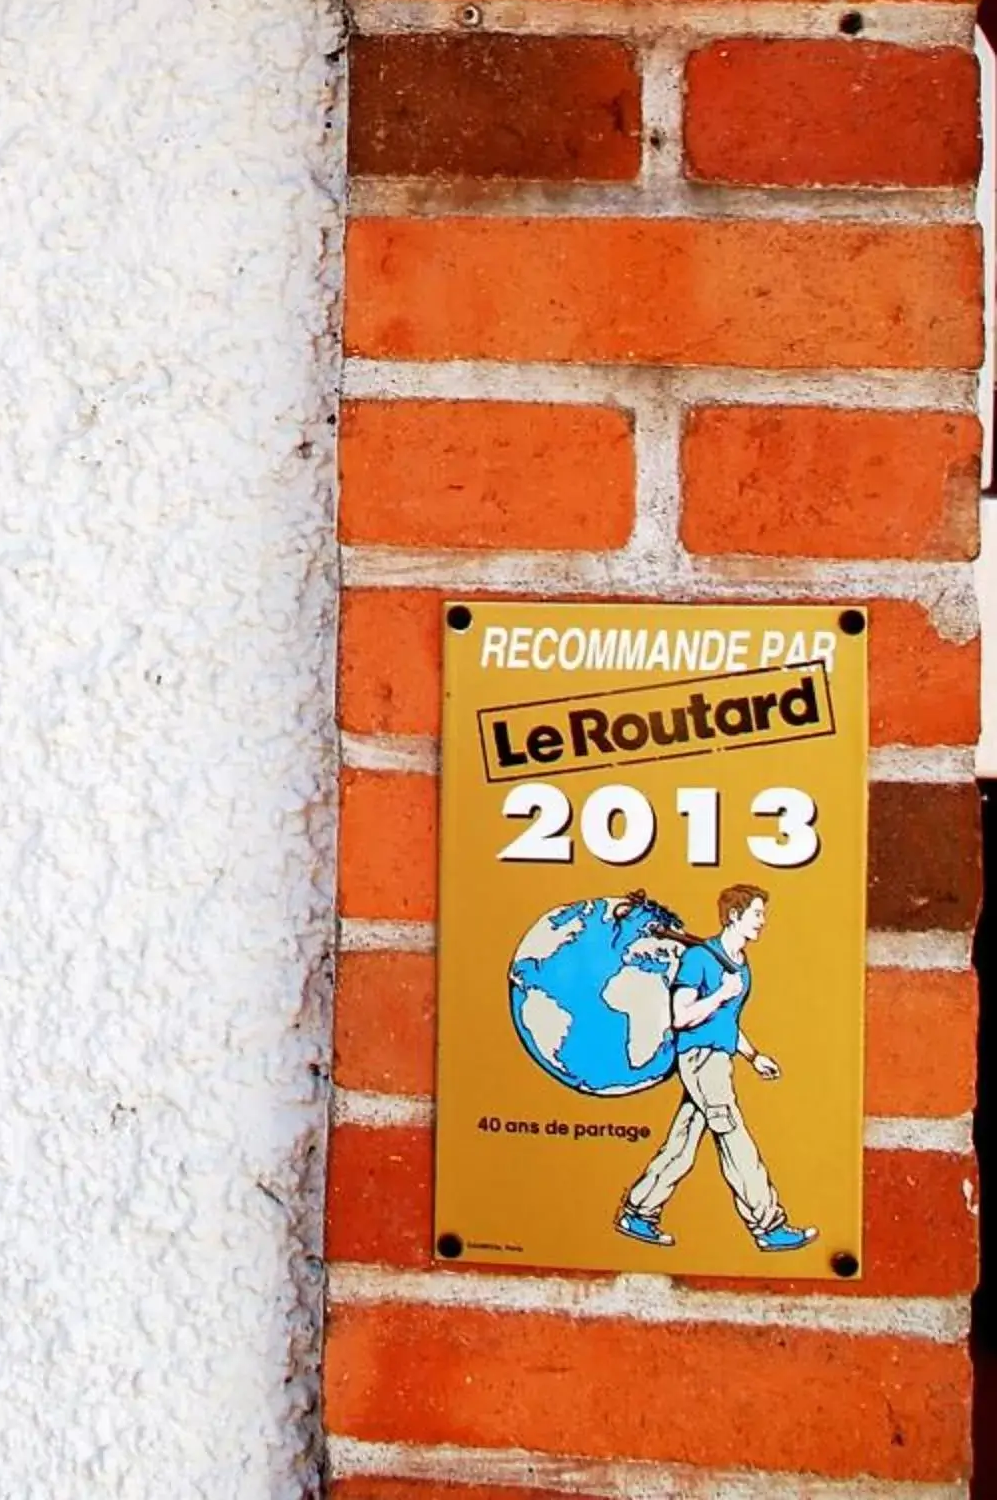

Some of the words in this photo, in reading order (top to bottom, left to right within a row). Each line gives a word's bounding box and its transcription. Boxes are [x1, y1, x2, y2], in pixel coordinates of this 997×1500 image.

[481, 627, 751, 672] RECOMMANDE
[760, 630, 837, 673] PAR
[496, 782, 821, 869] 2013
[478, 1116, 501, 1133] 40
[505, 1120, 540, 1134] ans
[545, 1119, 570, 1136] de
[574, 1123, 651, 1143] partage
